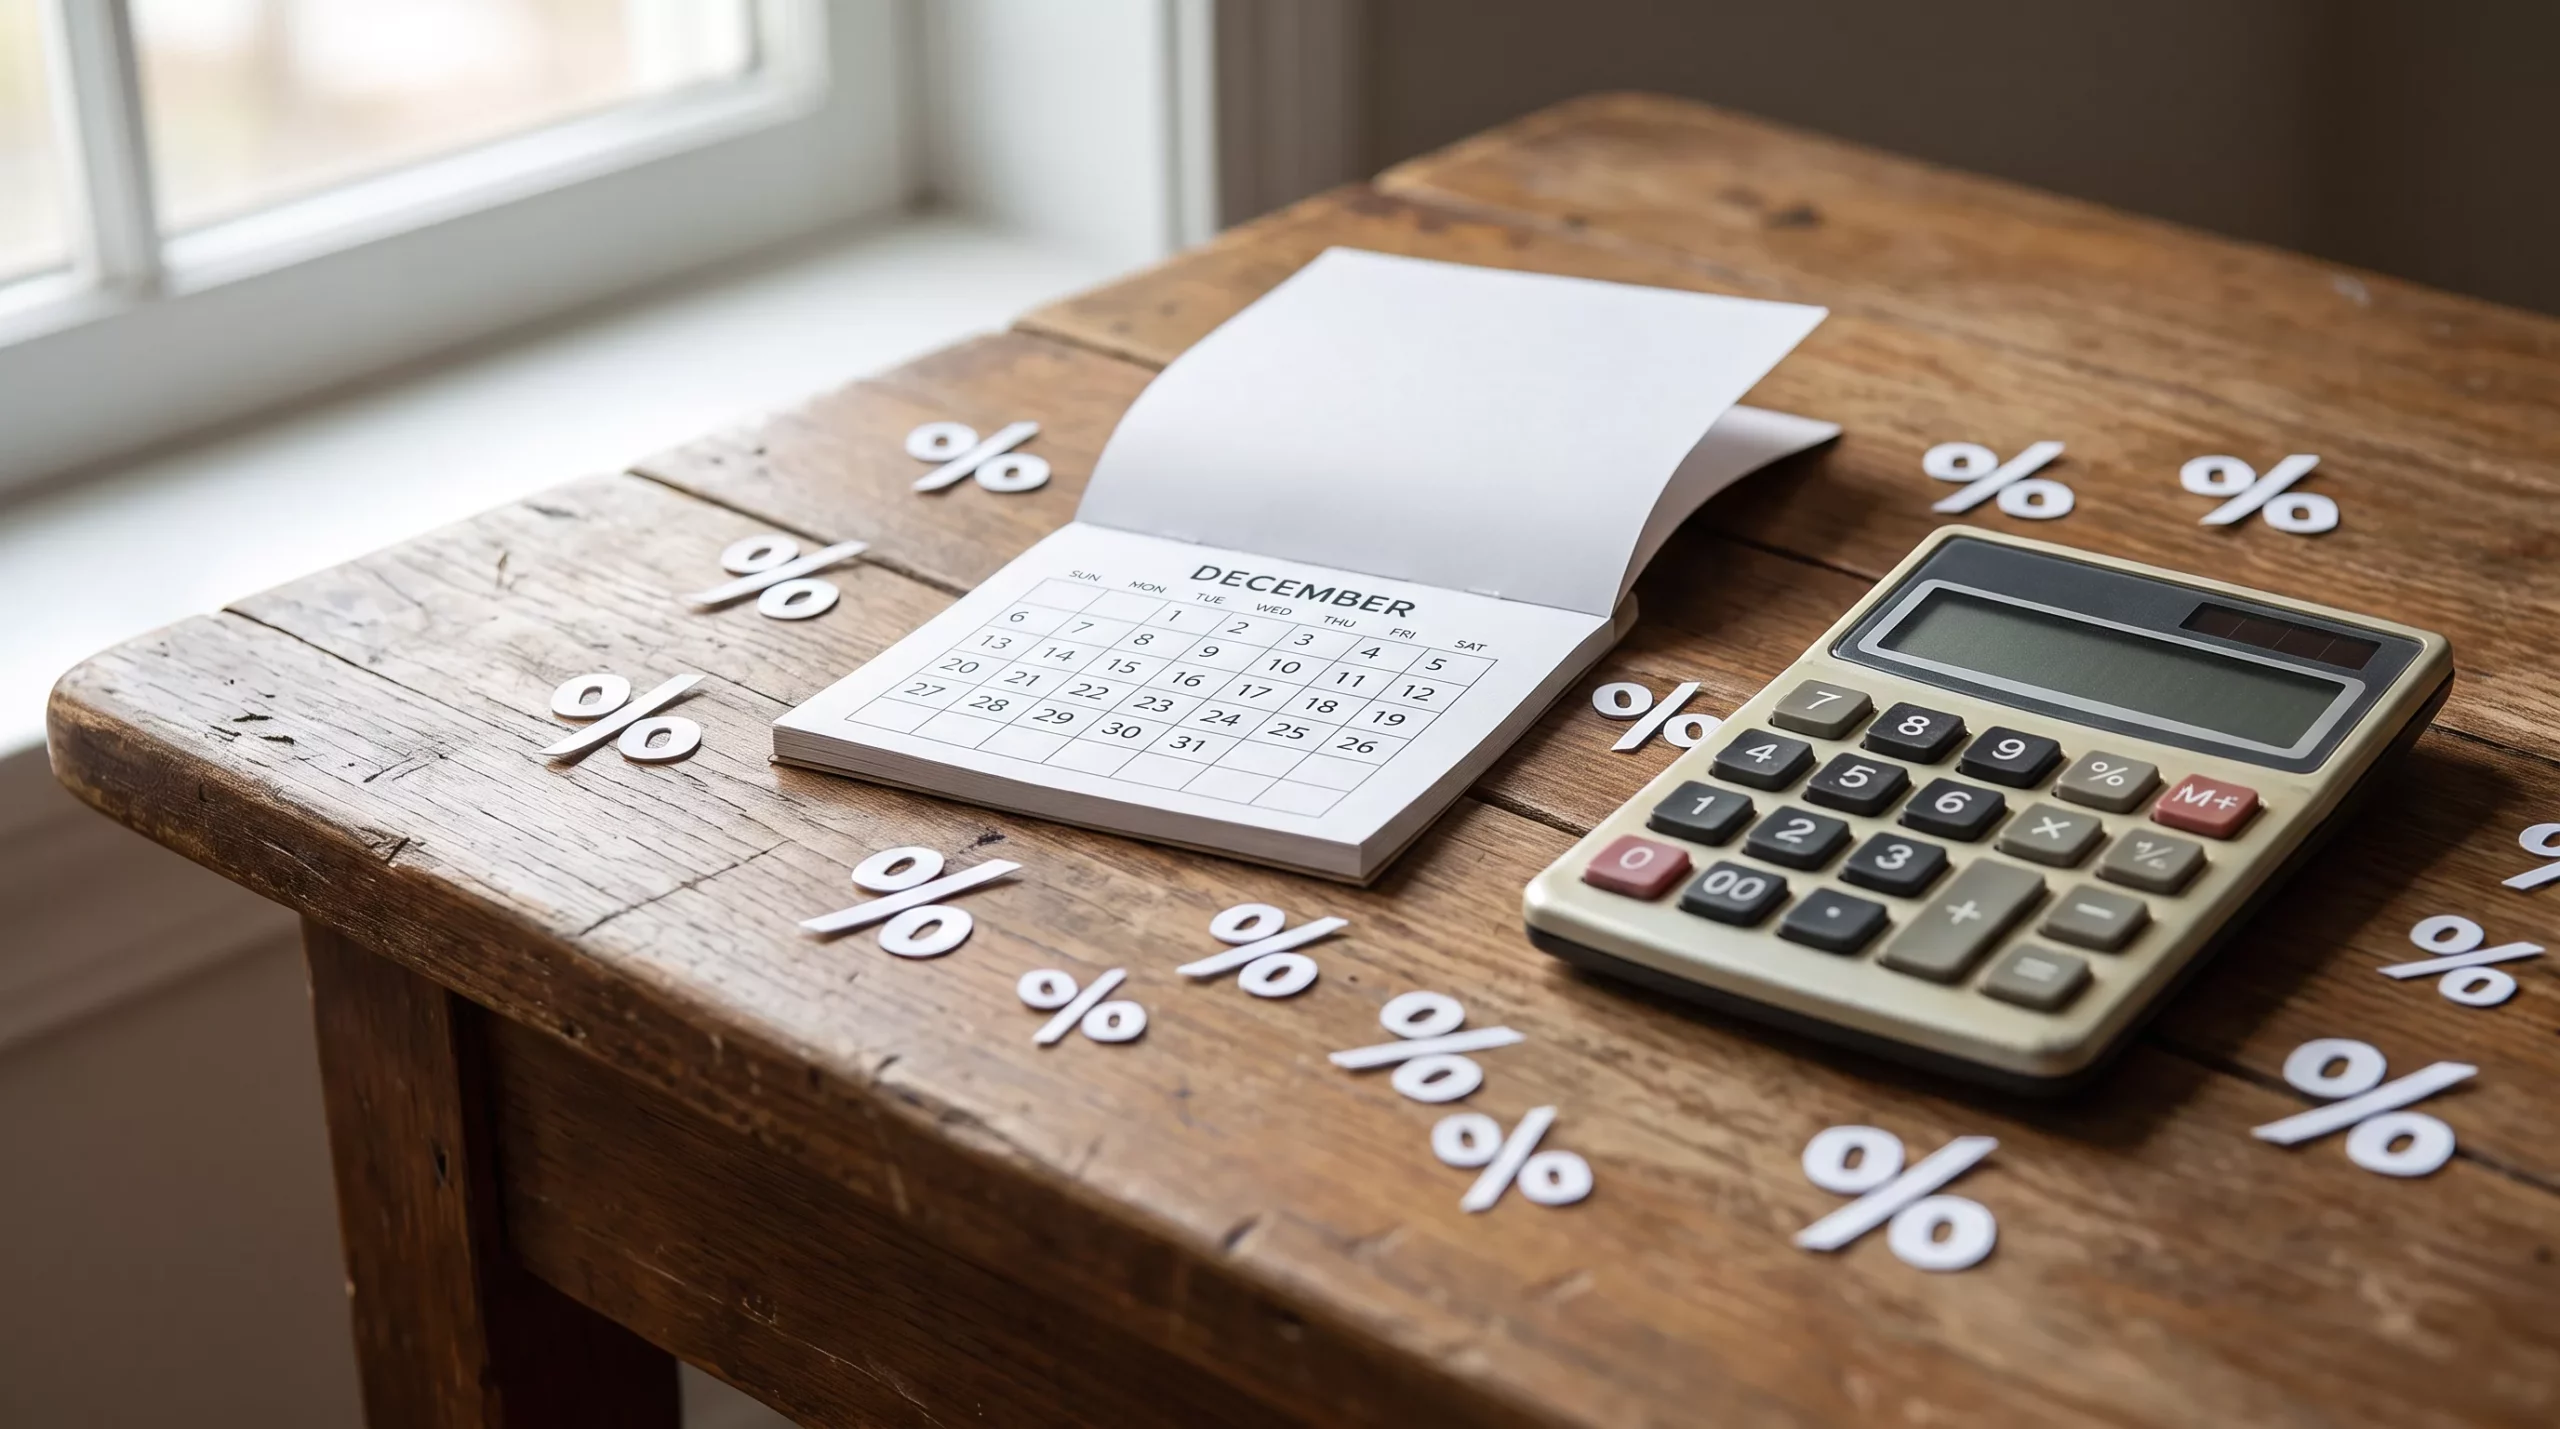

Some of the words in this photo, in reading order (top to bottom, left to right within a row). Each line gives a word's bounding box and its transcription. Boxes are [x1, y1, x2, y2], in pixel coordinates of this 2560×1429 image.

[905, 421, 1050, 493] %
[1922, 440, 2075, 519] %
[2179, 454, 2340, 533] %
[686, 534, 870, 620] %
[1068, 570, 1102, 583] SUN
[1128, 580, 1167, 594] MON
[1196, 592, 1226, 605] TUE
[1256, 603, 1292, 617] WED
[1323, 615, 1357, 628] THU
[1388, 628, 1417, 640] FRI
[1454, 639, 1488, 653] SAT
[1190, 564, 1416, 618] DECEMBER
[1009, 611, 1030, 623] 6
[1070, 621, 1095, 634] 7
[1133, 633, 1155, 646] 8
[1198, 645, 1220, 658] 9
[1268, 658, 1302, 675] 10
[1336, 671, 1366, 688] 11
[1402, 684, 1436, 702] 12
[1168, 610, 1183, 622] 1
[1226, 621, 1250, 635] 2
[1293, 633, 1315, 646] 3
[1360, 646, 1381, 660] 4
[1424, 657, 1448, 671] 5
[938, 657, 980, 674] 20
[1003, 670, 1041, 687] 21
[1067, 682, 1110, 701] 22
[1132, 695, 1174, 713] 23
[1199, 709, 1242, 727] 24
[1266, 722, 1311, 740] 25
[1336, 736, 1379, 754] 26
[980, 634, 1013, 650] 13
[1043, 647, 1076, 662] 14
[1107, 658, 1142, 674] 15
[1172, 671, 1206, 688] 16
[1238, 683, 1273, 699] 17
[1305, 697, 1339, 714] 18
[1372, 710, 1407, 727] 19
[1806, 690, 1843, 711] 7
[537, 673, 705, 762] %
[903, 682, 947, 697] 27
[967, 695, 1010, 712] 28
[1031, 708, 1075, 725] 29
[1101, 721, 1142, 739] 30
[1168, 735, 1206, 753] 31
[1745, 743, 1778, 763] 4
[1897, 715, 1931, 736] 8
[1991, 738, 2026, 760] 9
[1691, 795, 1715, 816] 1
[1839, 764, 1877, 788] 5
[1934, 791, 1972, 814] 6
[2088, 761, 2128, 786] %
[2172, 783, 2239, 810] M+
[1619, 846, 1655, 870] 0
[1774, 818, 1816, 844] 2
[1875, 844, 1913, 870] 3
[801, 847, 1022, 957] %
[1702, 870, 1766, 901] 00
[1176, 903, 1349, 996] %
[2376, 914, 2546, 1006] %
[1017, 968, 1148, 1046] %
[1328, 990, 1526, 1103] %
[2251, 1038, 2478, 1177] %
[1431, 1105, 1593, 1211] %
[1794, 1125, 1998, 1271] %
